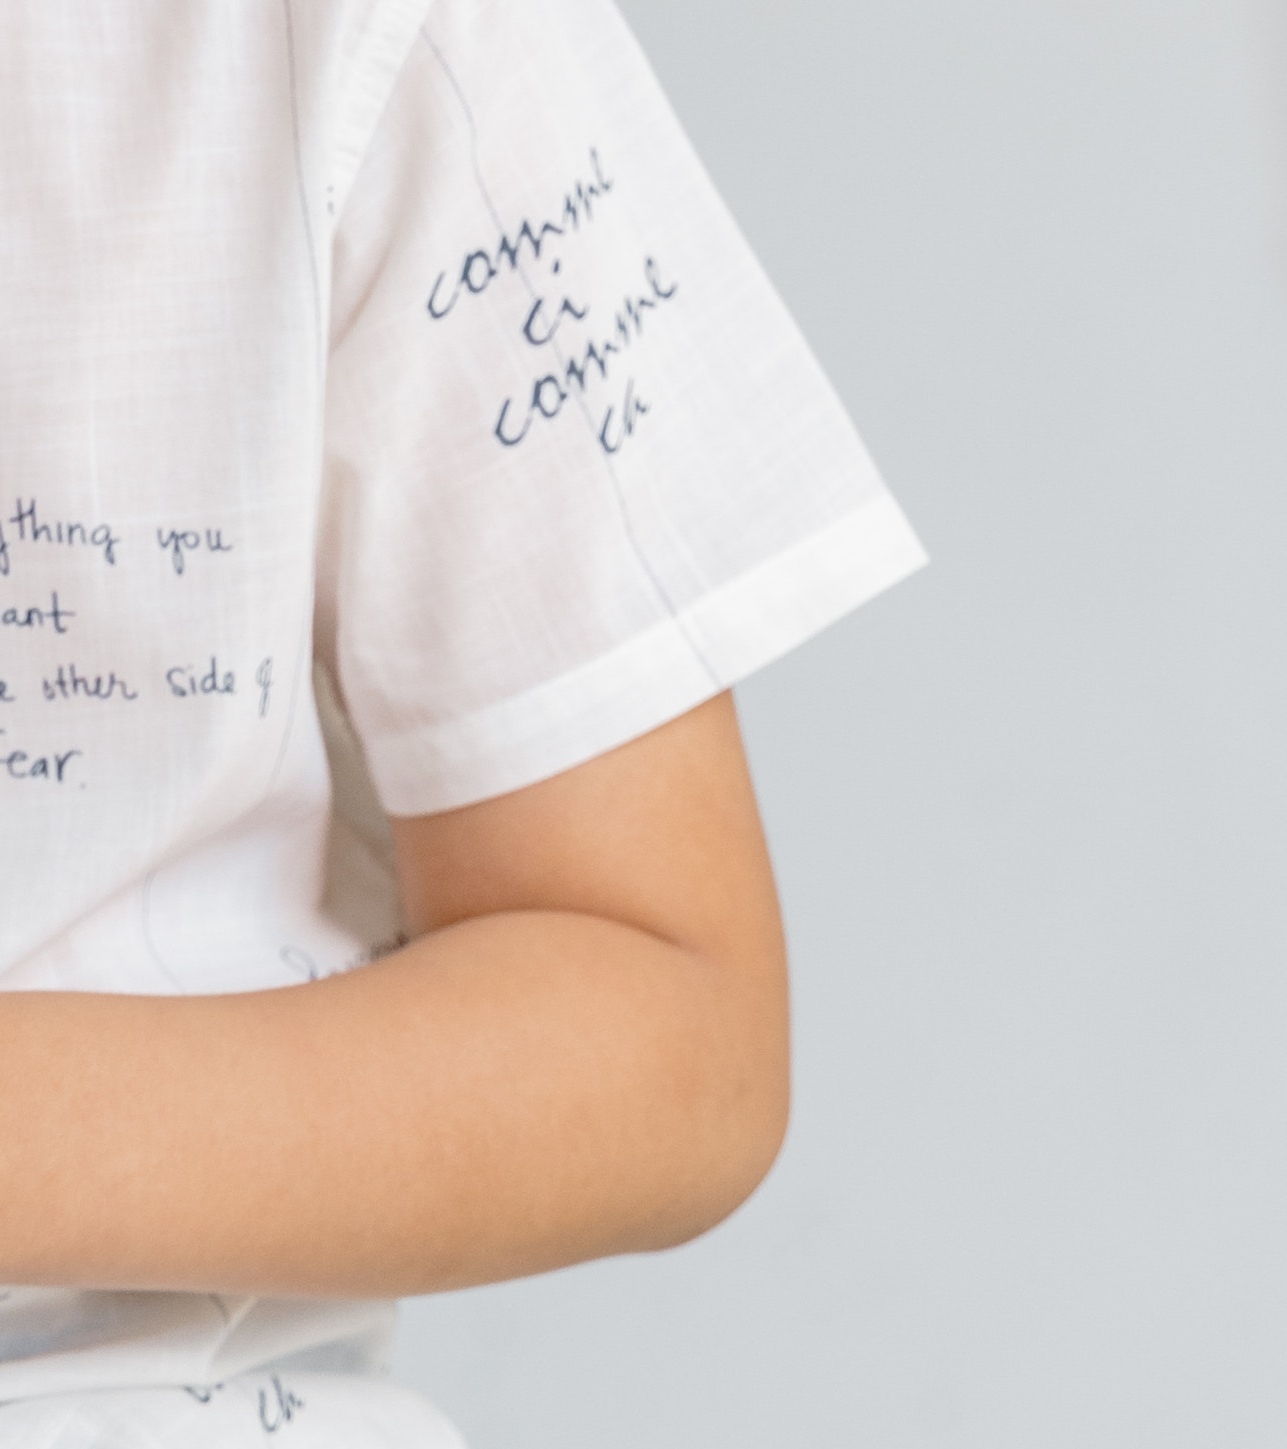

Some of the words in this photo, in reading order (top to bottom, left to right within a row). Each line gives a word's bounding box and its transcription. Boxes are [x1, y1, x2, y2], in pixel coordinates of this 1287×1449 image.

[155, 526, 234, 577] you
[39, 660, 141, 704] other
[162, 653, 239, 701] side
